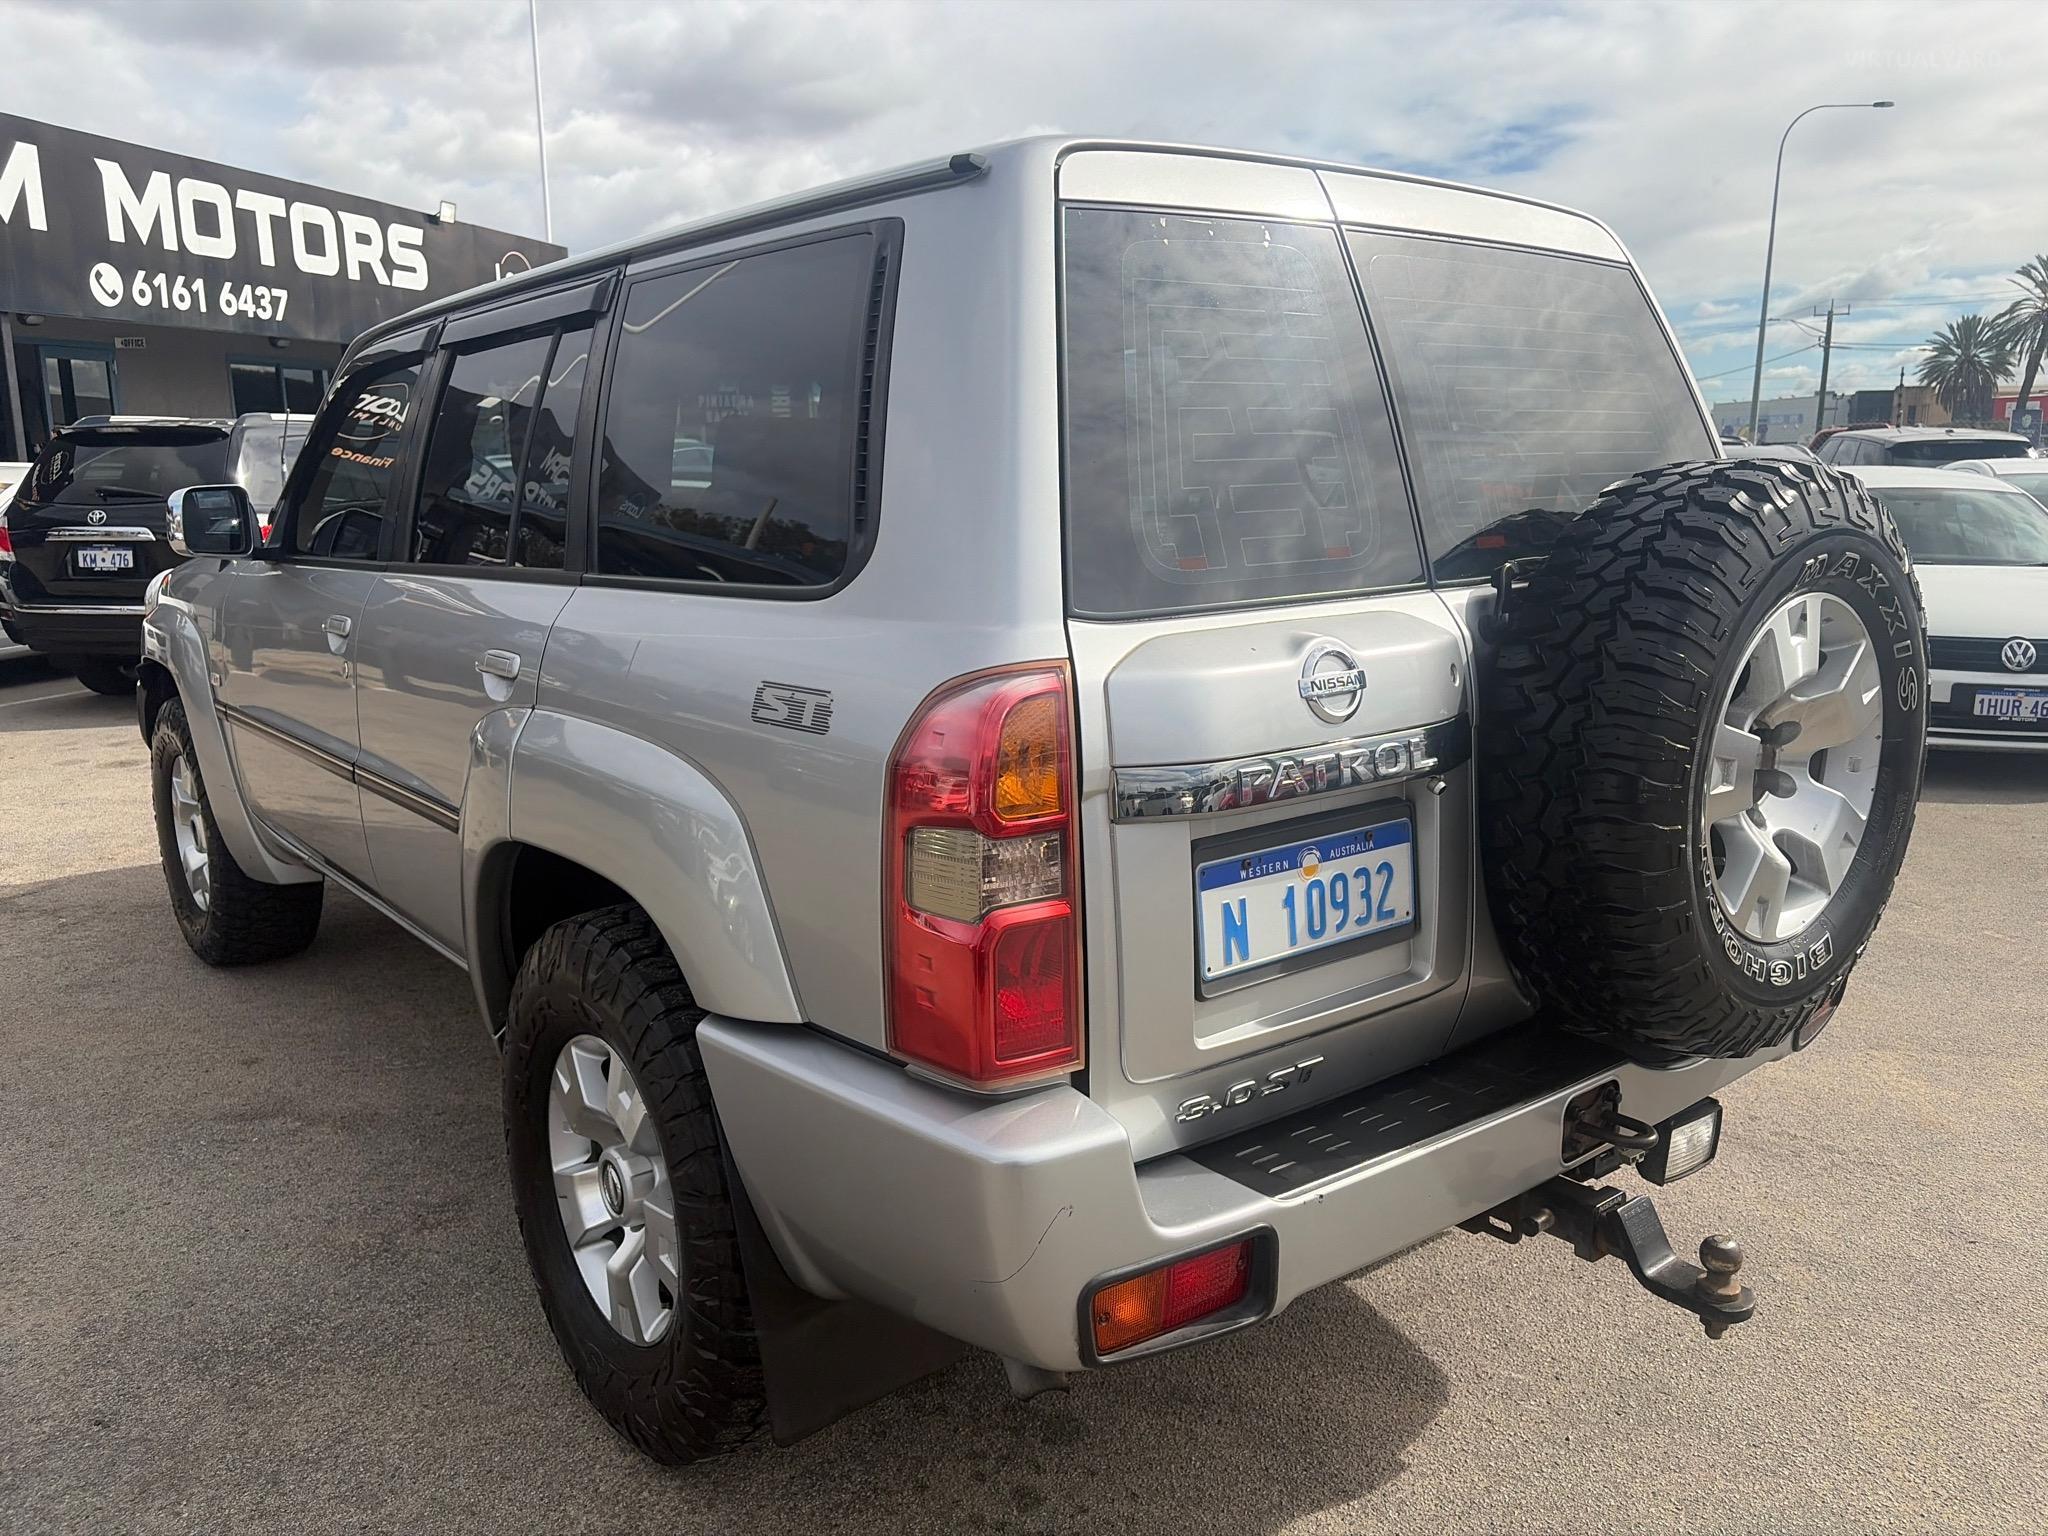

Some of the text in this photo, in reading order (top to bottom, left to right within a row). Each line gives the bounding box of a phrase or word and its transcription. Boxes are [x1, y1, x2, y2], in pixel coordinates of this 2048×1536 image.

[93, 157, 430, 292] MOTORS
[131, 269, 289, 322] 6161 6437
[82, 553, 130, 568] KM 476
[1793, 551, 1918, 711] MAXXIS
[756, 682, 834, 732] ST
[1309, 672, 1364, 694] NISSAN
[1979, 698, 2022, 716] 1HUR
[1236, 733, 1439, 805] PATROL
[1240, 840, 1375, 880] WESTERN AUSTRALIA
[1221, 860, 1396, 966] N 10932
